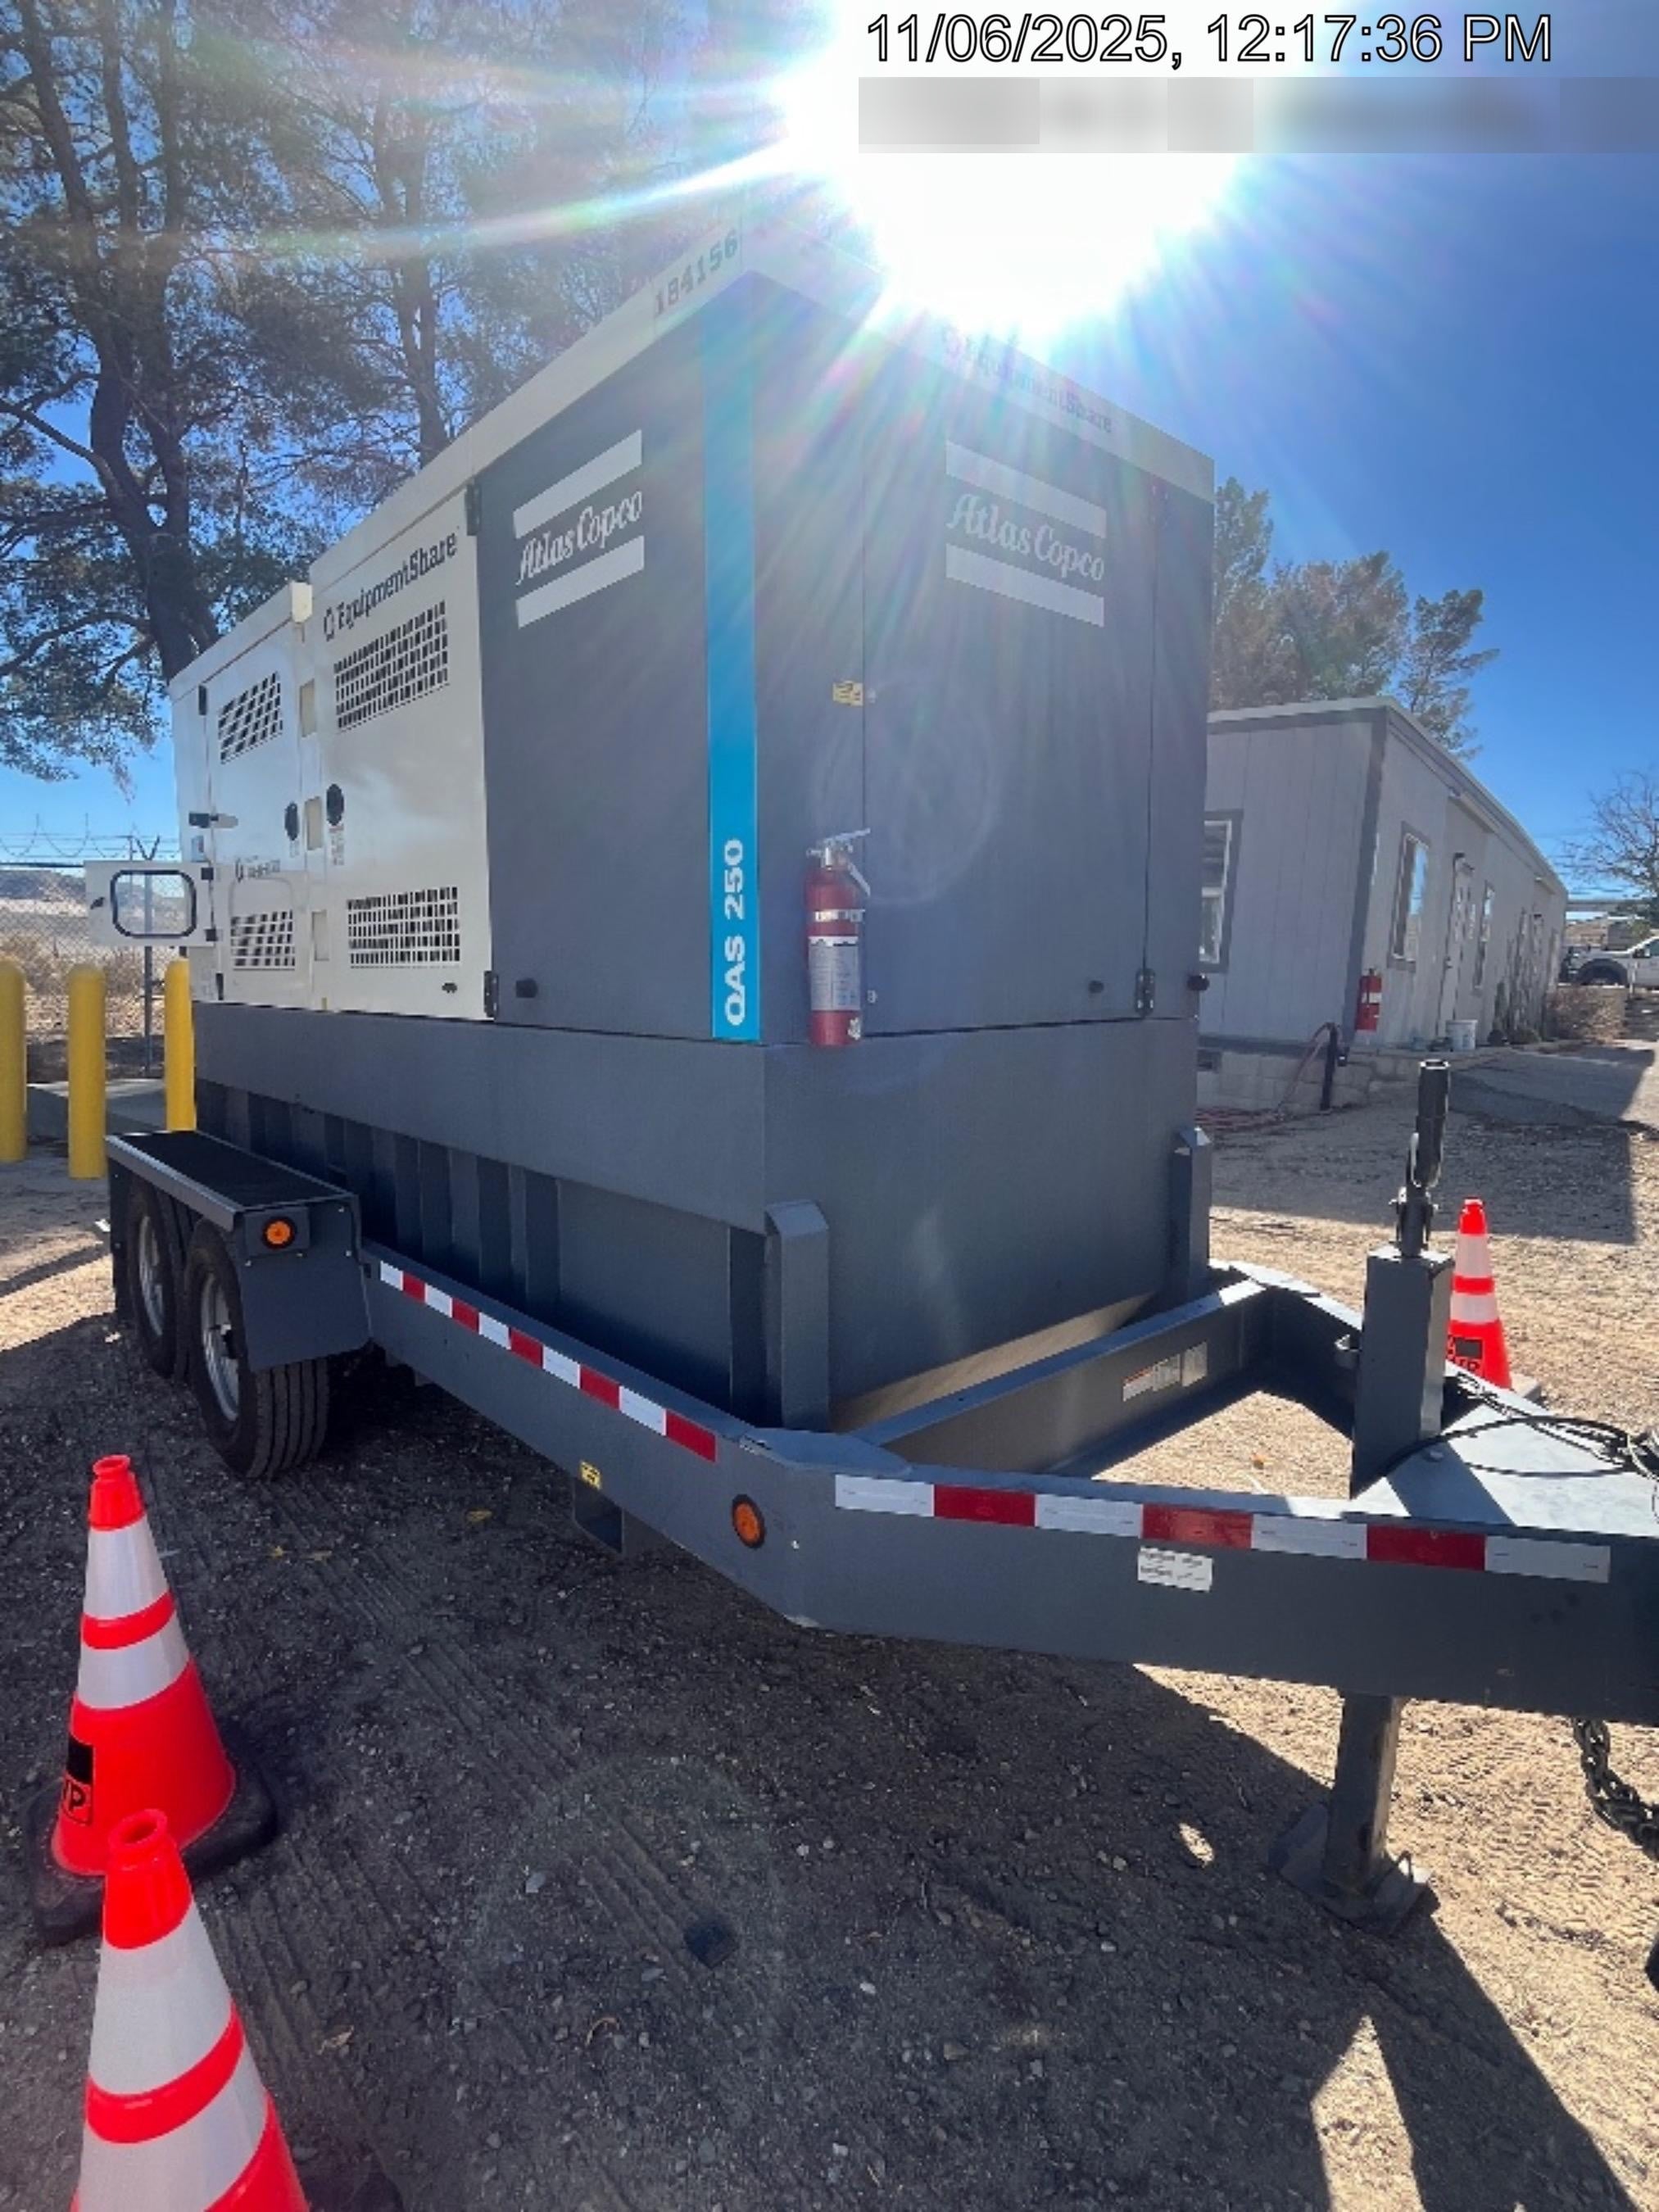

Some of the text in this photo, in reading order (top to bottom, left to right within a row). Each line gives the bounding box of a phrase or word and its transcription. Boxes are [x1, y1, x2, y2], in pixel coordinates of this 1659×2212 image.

[655, 229, 738, 316] 184156
[336, 532, 458, 630] EquipmentShare
[515, 491, 643, 586] Atlas Copco
[945, 492, 1105, 582] Atlas Copco
[724, 838, 746, 1027] QAS 250
